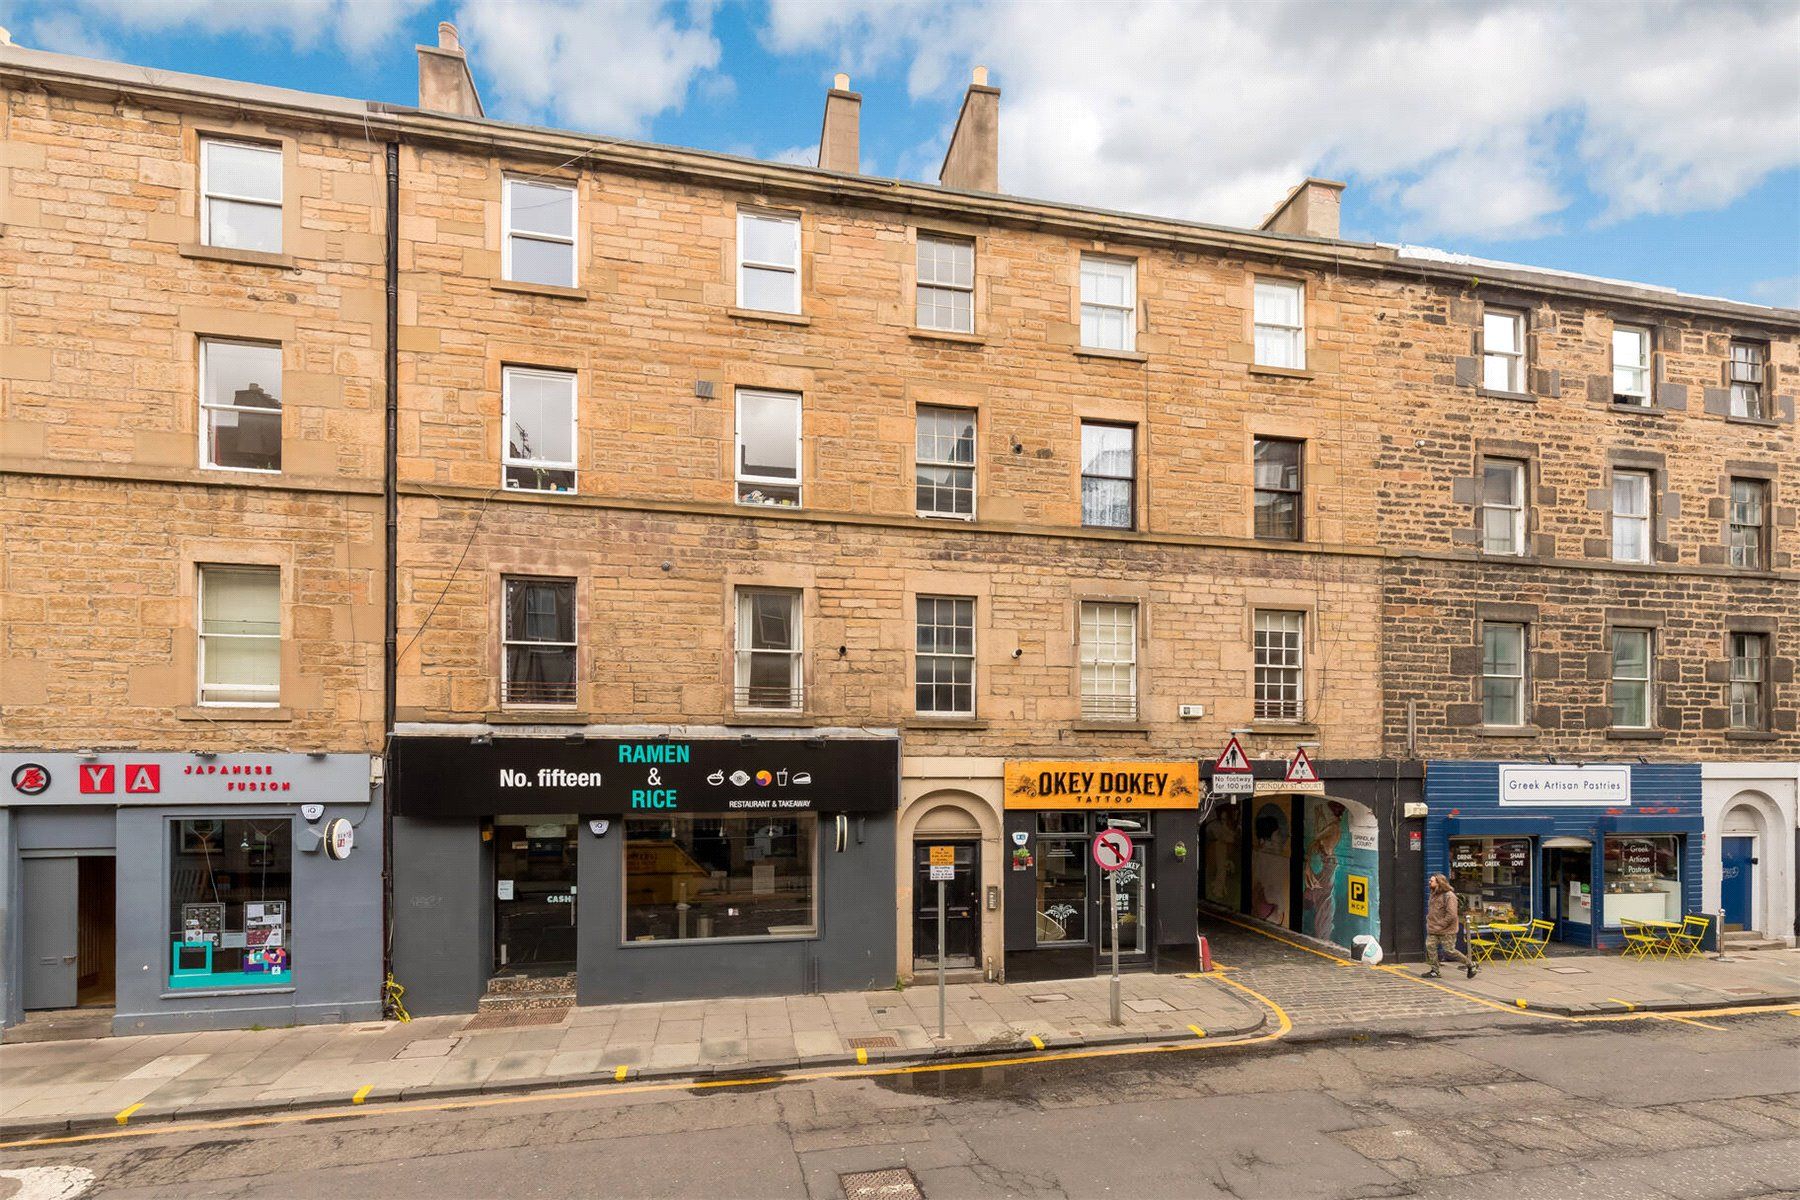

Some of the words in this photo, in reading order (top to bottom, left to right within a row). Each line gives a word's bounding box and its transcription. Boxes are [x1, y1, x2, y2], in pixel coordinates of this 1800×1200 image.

[618, 744, 690, 763] RAMEN
[184, 765, 273, 775] JAPANESE
[499, 769, 532, 787] No.
[537, 769, 602, 787] fifteen
[647, 767, 661, 786] &
[1226, 775, 1251, 784] footway
[227, 782, 291, 792] FUSION
[1039, 772, 1094, 797] OKEY
[1100, 772, 1168, 796] DOKEY
[1509, 780, 1539, 790] Greek
[1544, 780, 1579, 790] Artisan
[1583, 780, 1621, 790] Pastries
[632, 790, 677, 808] RICE
[729, 800, 771, 808] RESTAURANT
[546, 895, 573, 904] CASH
